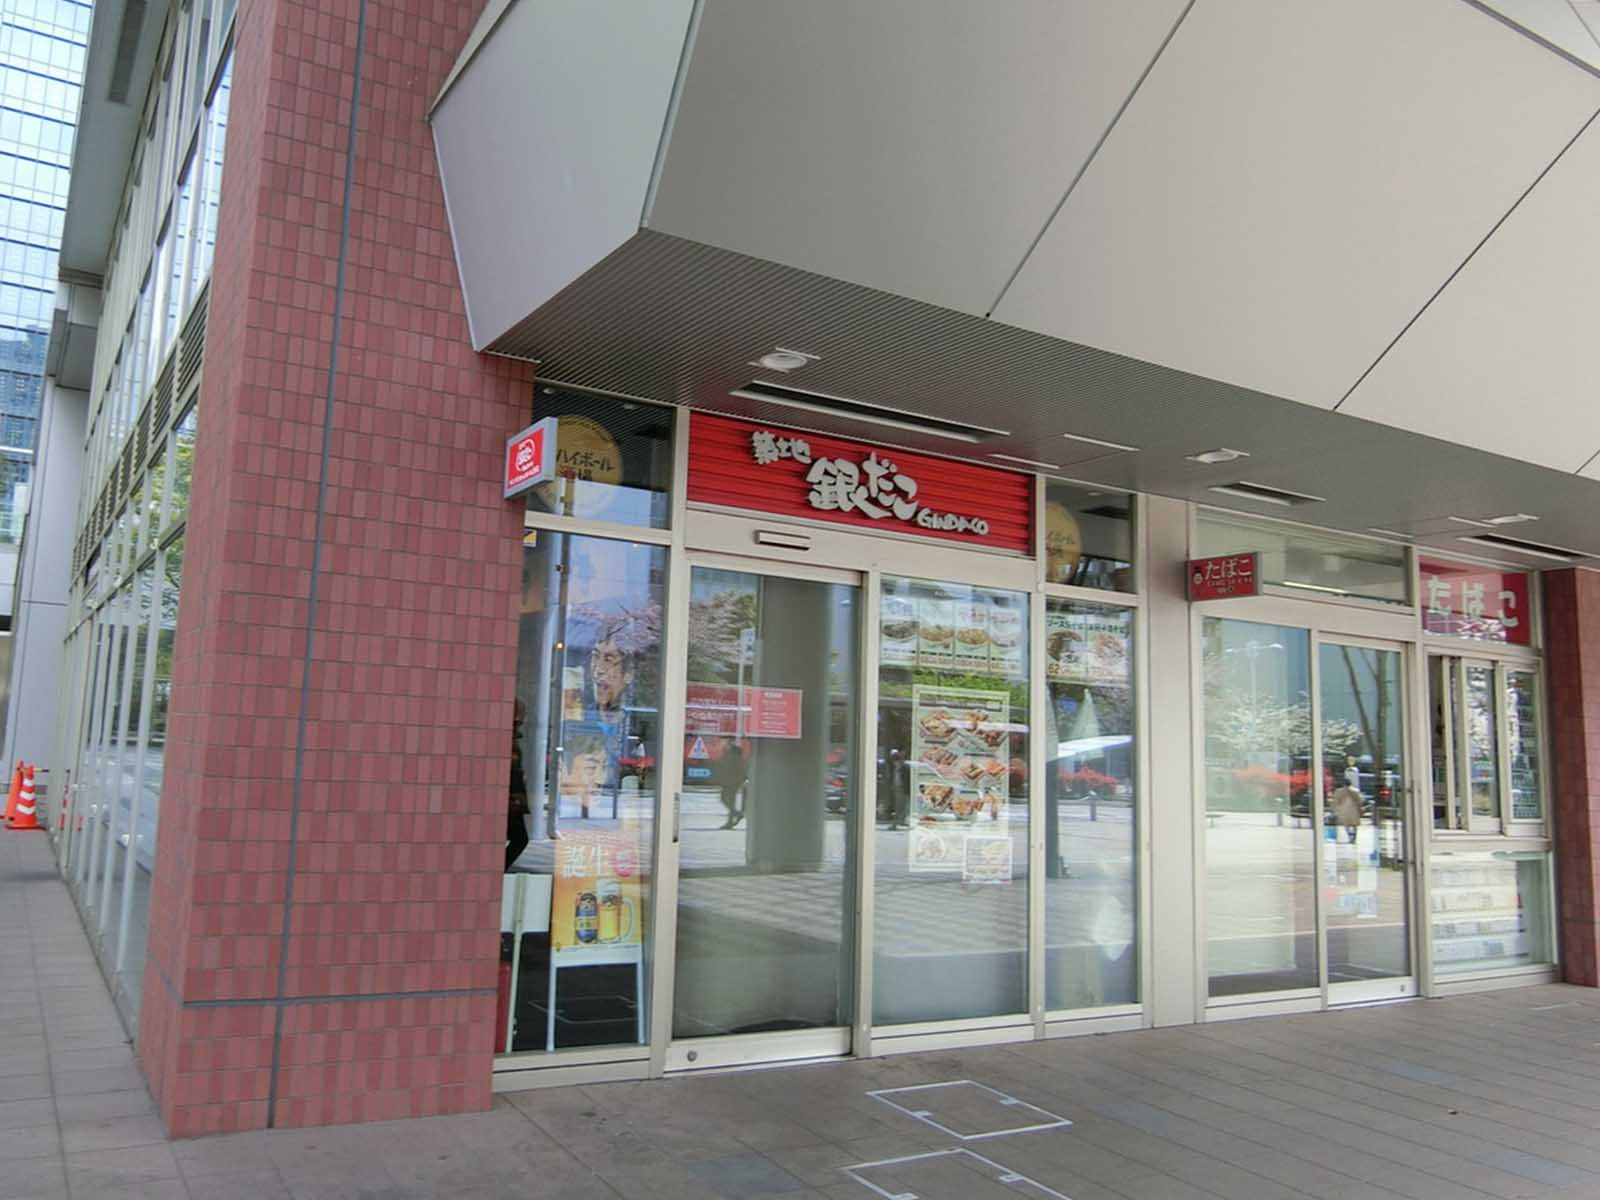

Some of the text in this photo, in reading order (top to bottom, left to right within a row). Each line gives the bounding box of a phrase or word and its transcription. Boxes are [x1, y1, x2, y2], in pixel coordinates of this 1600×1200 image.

[556, 449, 617, 473] ハイボール
[805, 451, 919, 521] 銀だこ
[1204, 557, 1253, 580] たばこ
[1427, 575, 1520, 628] たばこ
